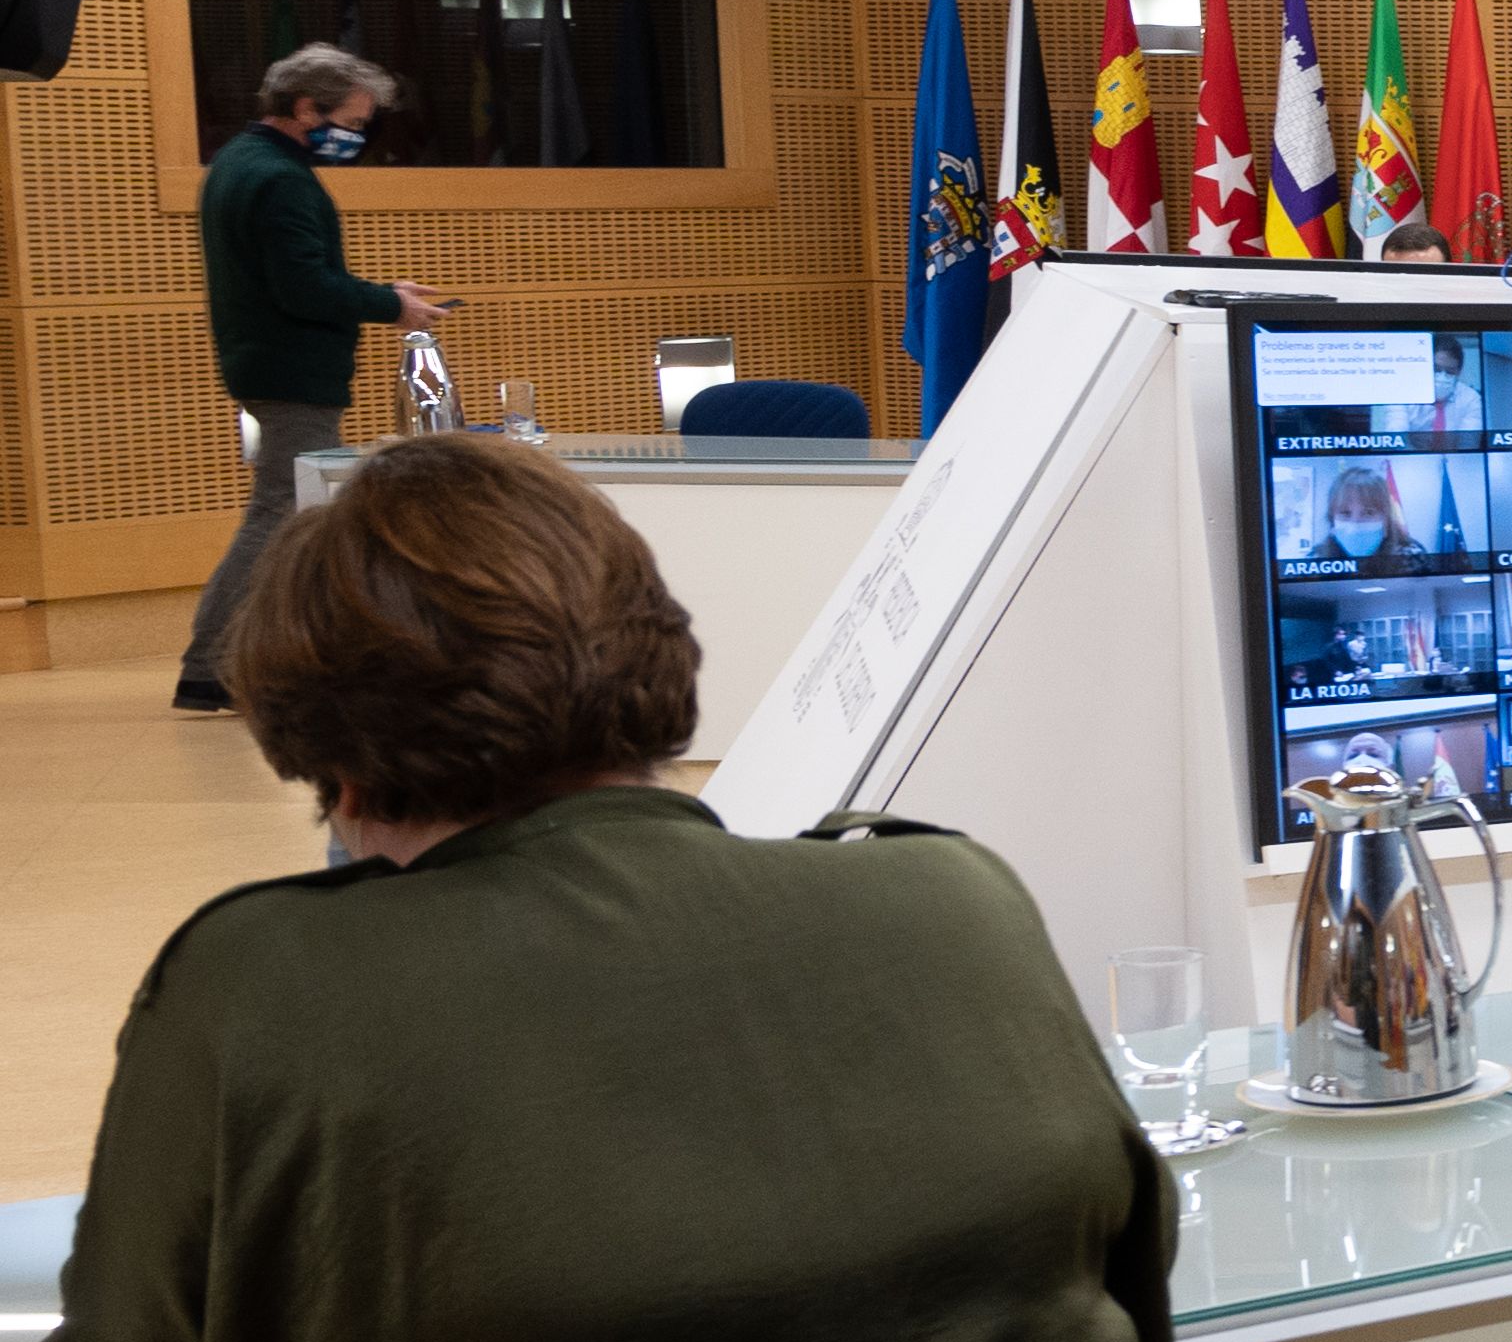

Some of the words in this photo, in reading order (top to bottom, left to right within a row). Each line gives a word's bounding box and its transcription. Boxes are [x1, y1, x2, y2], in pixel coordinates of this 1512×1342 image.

[1261, 340, 1315, 351] Problemas
[1317, 342, 1350, 353] graves
[1353, 340, 1365, 351] de
[1369, 340, 1385, 351] red
[1278, 434, 1406, 451] EXTREMADURA
[1284, 559, 1358, 576] ARAGON
[1290, 686, 1312, 701] LA
[1317, 682, 1371, 699] RIOJA
